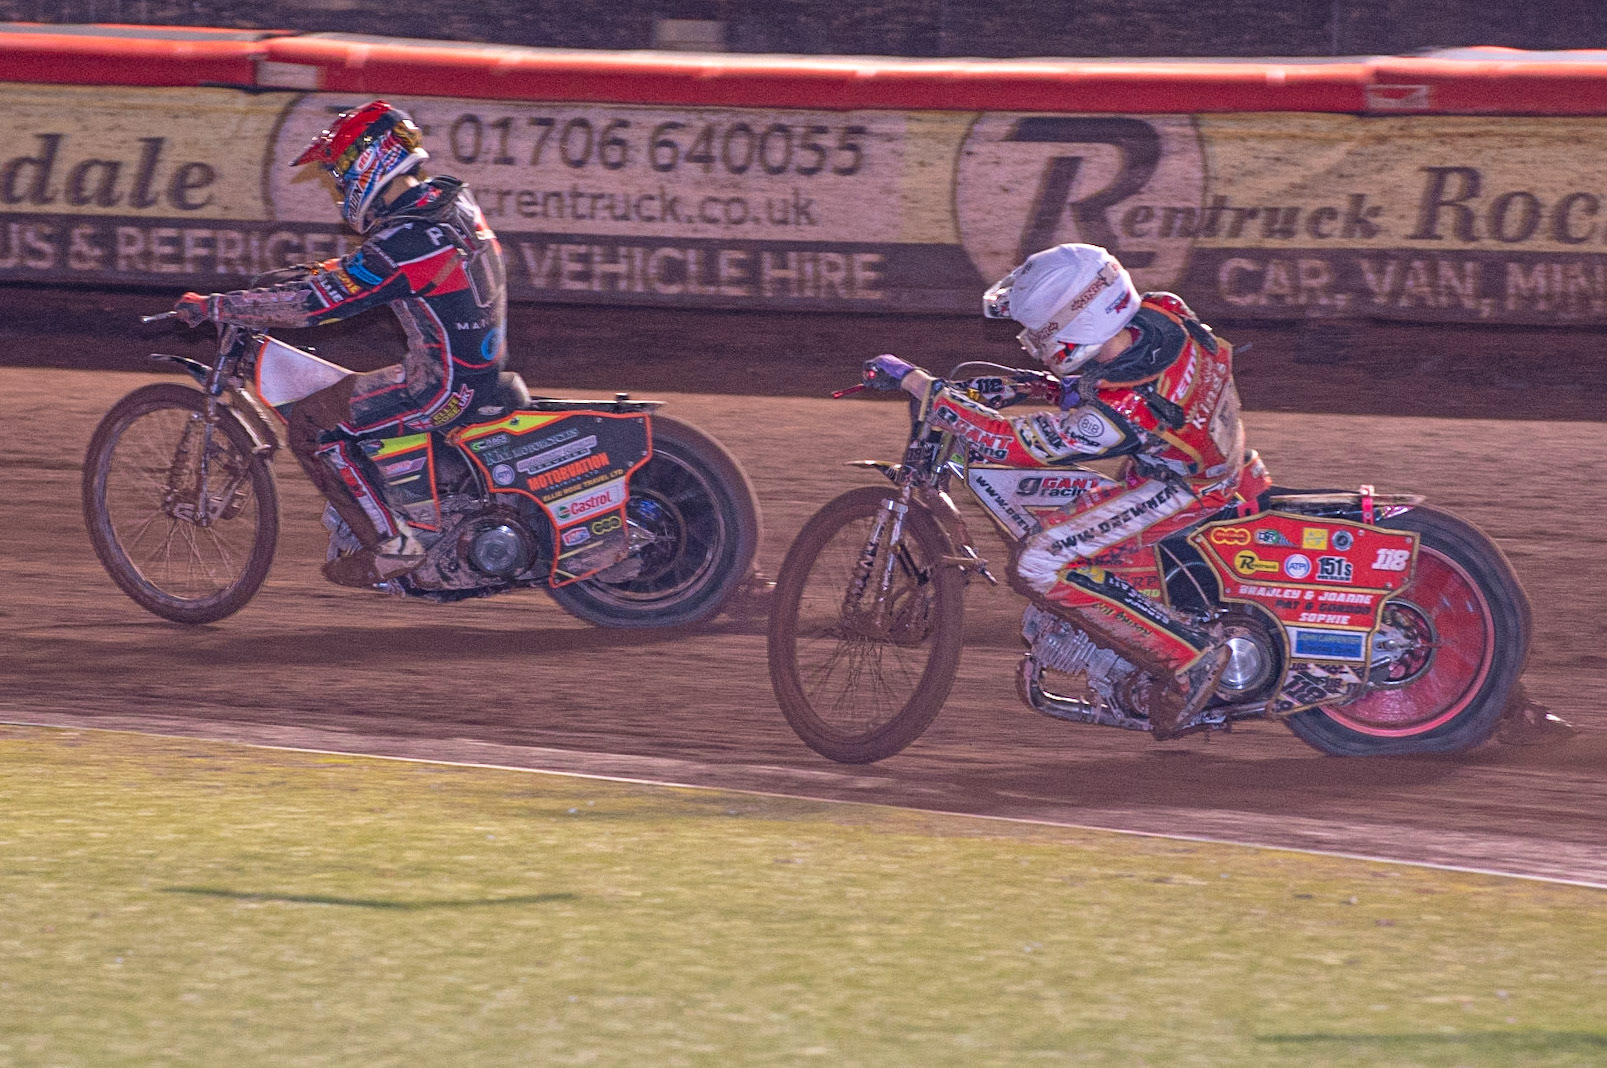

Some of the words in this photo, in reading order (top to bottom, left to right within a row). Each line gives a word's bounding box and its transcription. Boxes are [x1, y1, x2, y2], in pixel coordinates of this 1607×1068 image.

[449, 114, 633, 171] 01706
[648, 120, 867, 177] 640055
[68, 226, 100, 270] &
[521, 241, 750, 298] VEHICLE
[763, 250, 888, 300] HIRE
[526, 452, 610, 491] MOTORVATION
[582, 473, 609, 487] TRAVEL
[609, 468, 623, 477] LTD
[570, 492, 613, 516] Castrol
[1371, 548, 1411, 571] 118
[1318, 591, 1375, 605] JOANNE
[1298, 612, 1351, 625] SOPHIE
